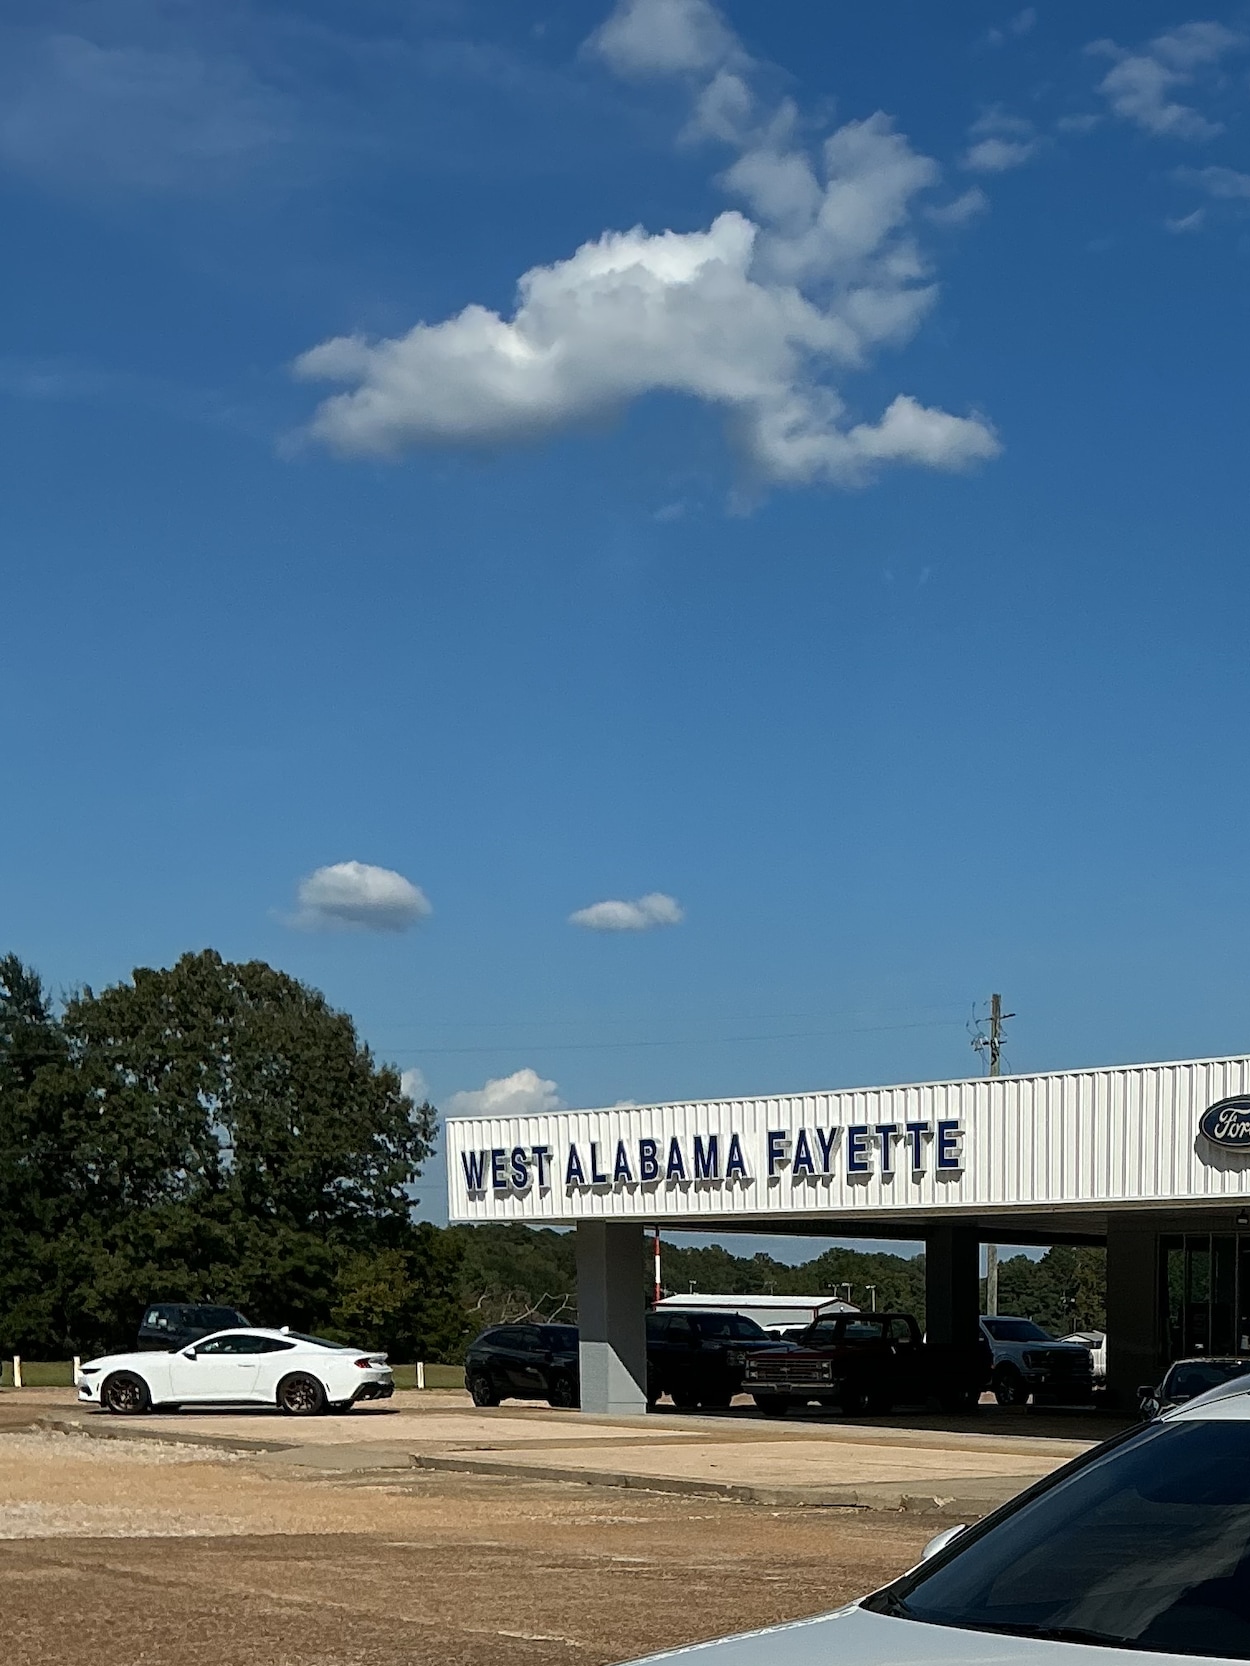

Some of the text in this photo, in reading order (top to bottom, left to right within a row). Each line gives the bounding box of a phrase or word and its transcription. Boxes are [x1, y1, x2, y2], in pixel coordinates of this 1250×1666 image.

[460, 1119, 961, 1190] WEST ALABAMA FAYETTE
